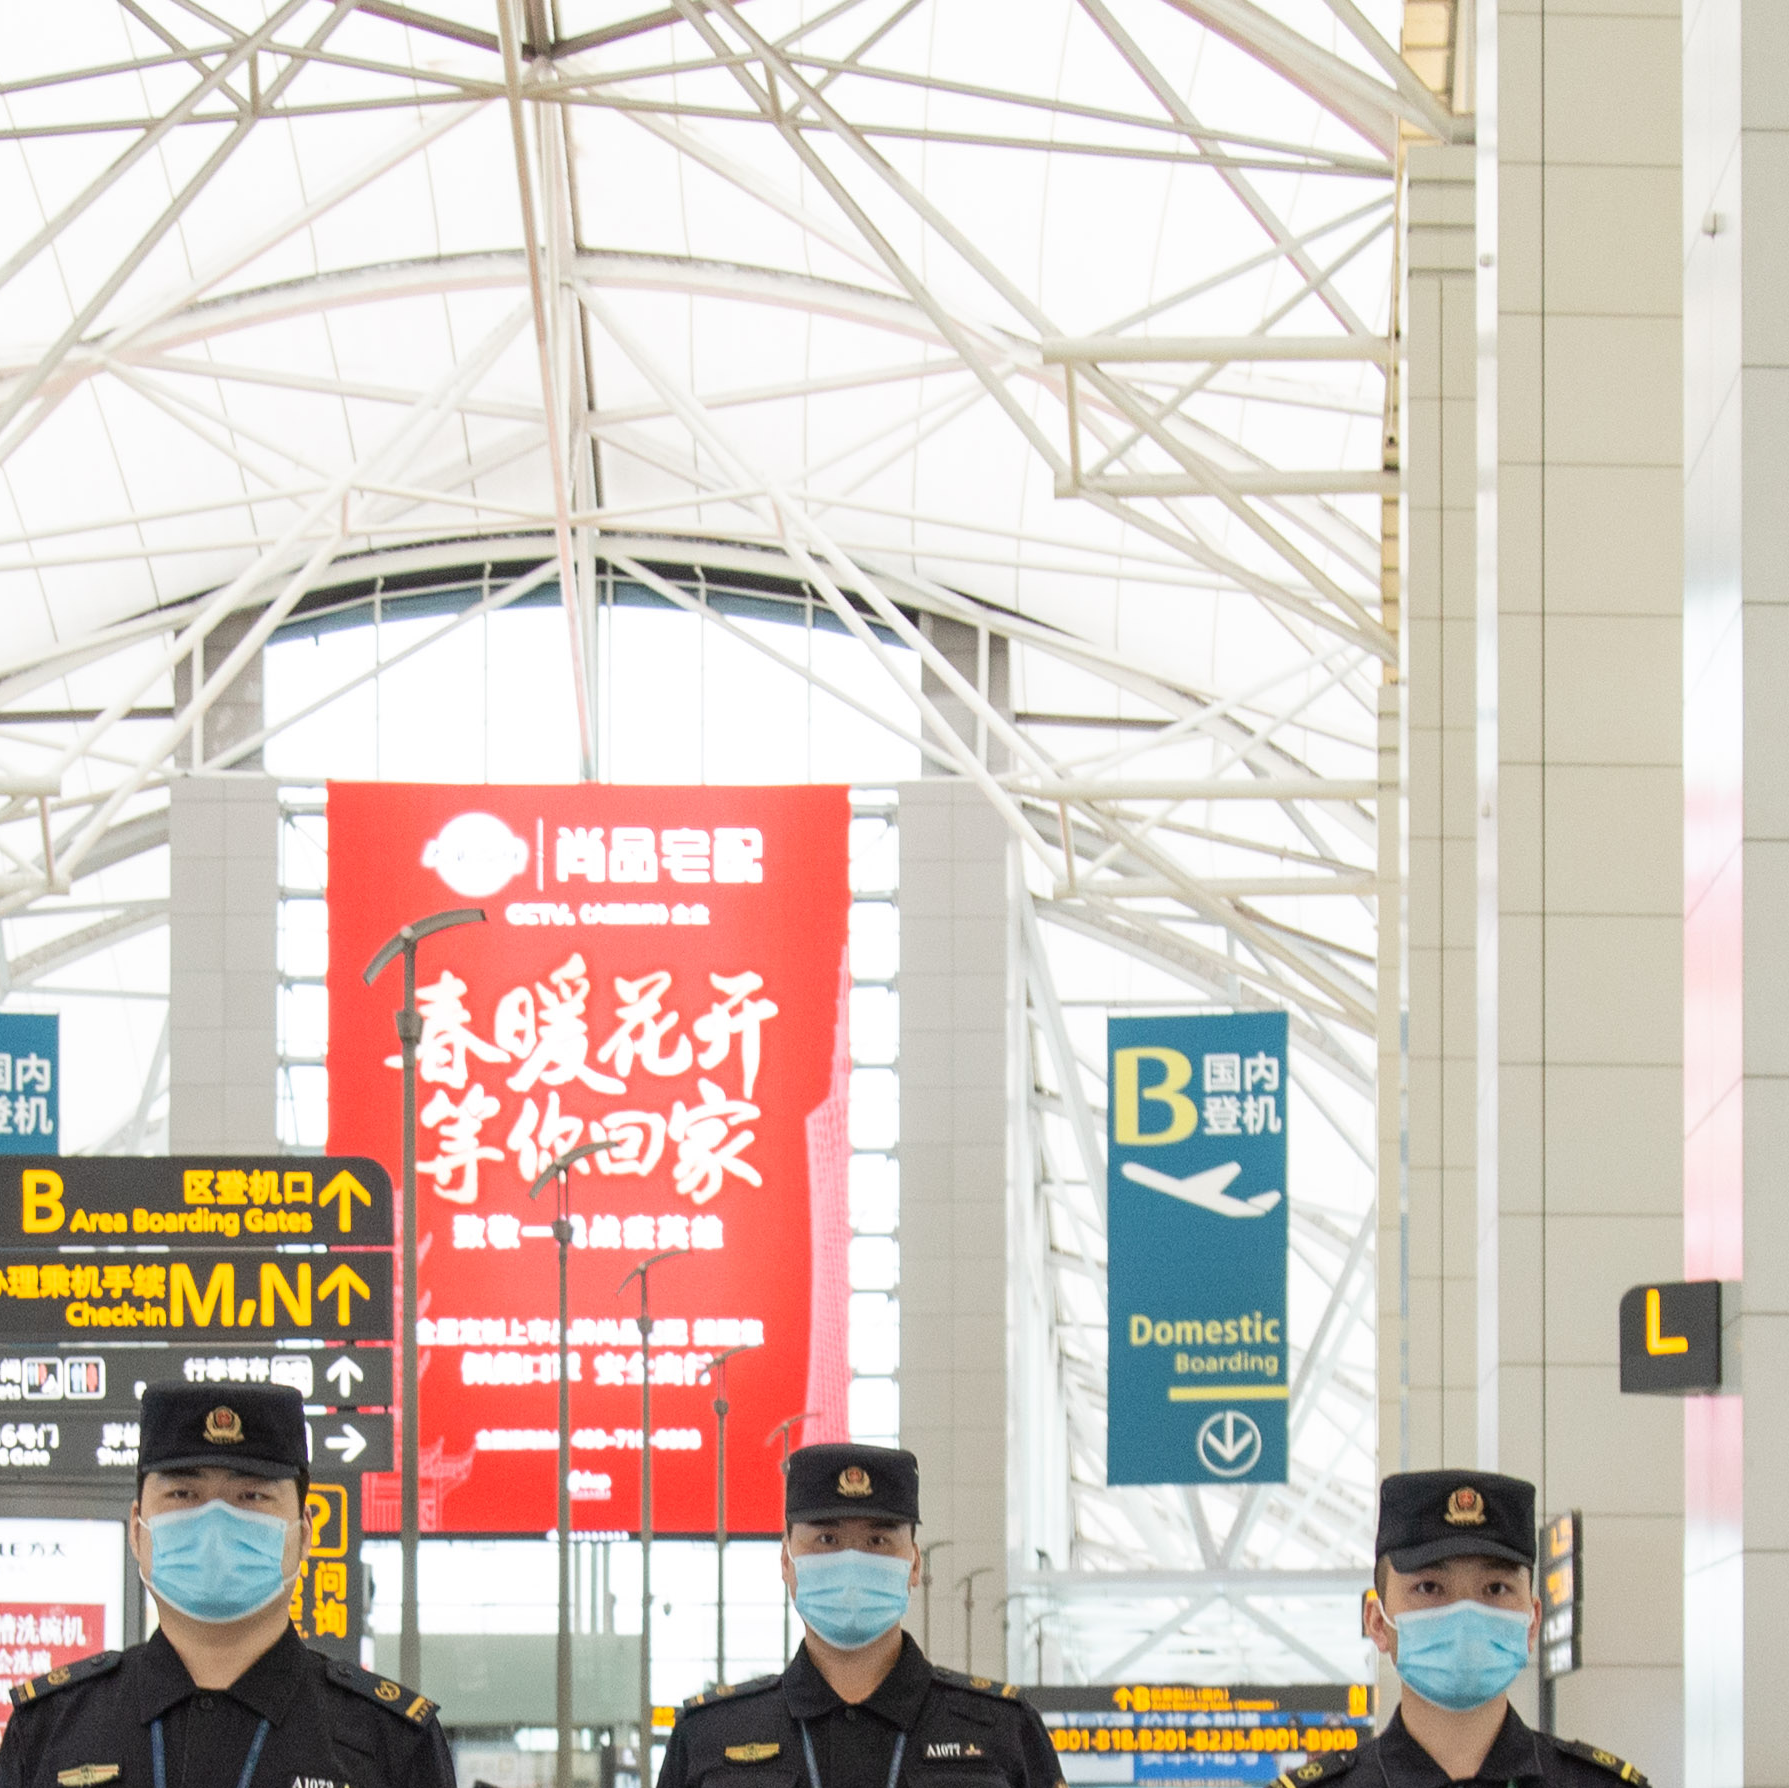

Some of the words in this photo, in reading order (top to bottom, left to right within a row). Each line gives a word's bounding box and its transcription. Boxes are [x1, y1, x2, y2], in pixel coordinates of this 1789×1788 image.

[556, 827, 763, 884] 尚品宅配
[385, 954, 779, 1100] 春暖花开
[1203, 1051, 1280, 1093] 国内
[1115, 1047, 1199, 1146] B
[1202, 1094, 1283, 1135] 登机
[416, 1078, 763, 1204] 等你回家
[22, 1169, 66, 1233] B
[184, 1169, 313, 1205] 区登机口
[70, 1209, 127, 1233] Area
[133, 1207, 240, 1237] Boarding
[244, 1208, 313, 1233] Gates
[65, 1301, 167, 1328] Check-in
[169, 1263, 313, 1327] M,N
[1130, 1310, 1280, 1346] Domestic
[1646, 1288, 1689, 1356] L
[1175, 1352, 1279, 1377] Boarding
[10, 1447, 51, 1465] Gate
